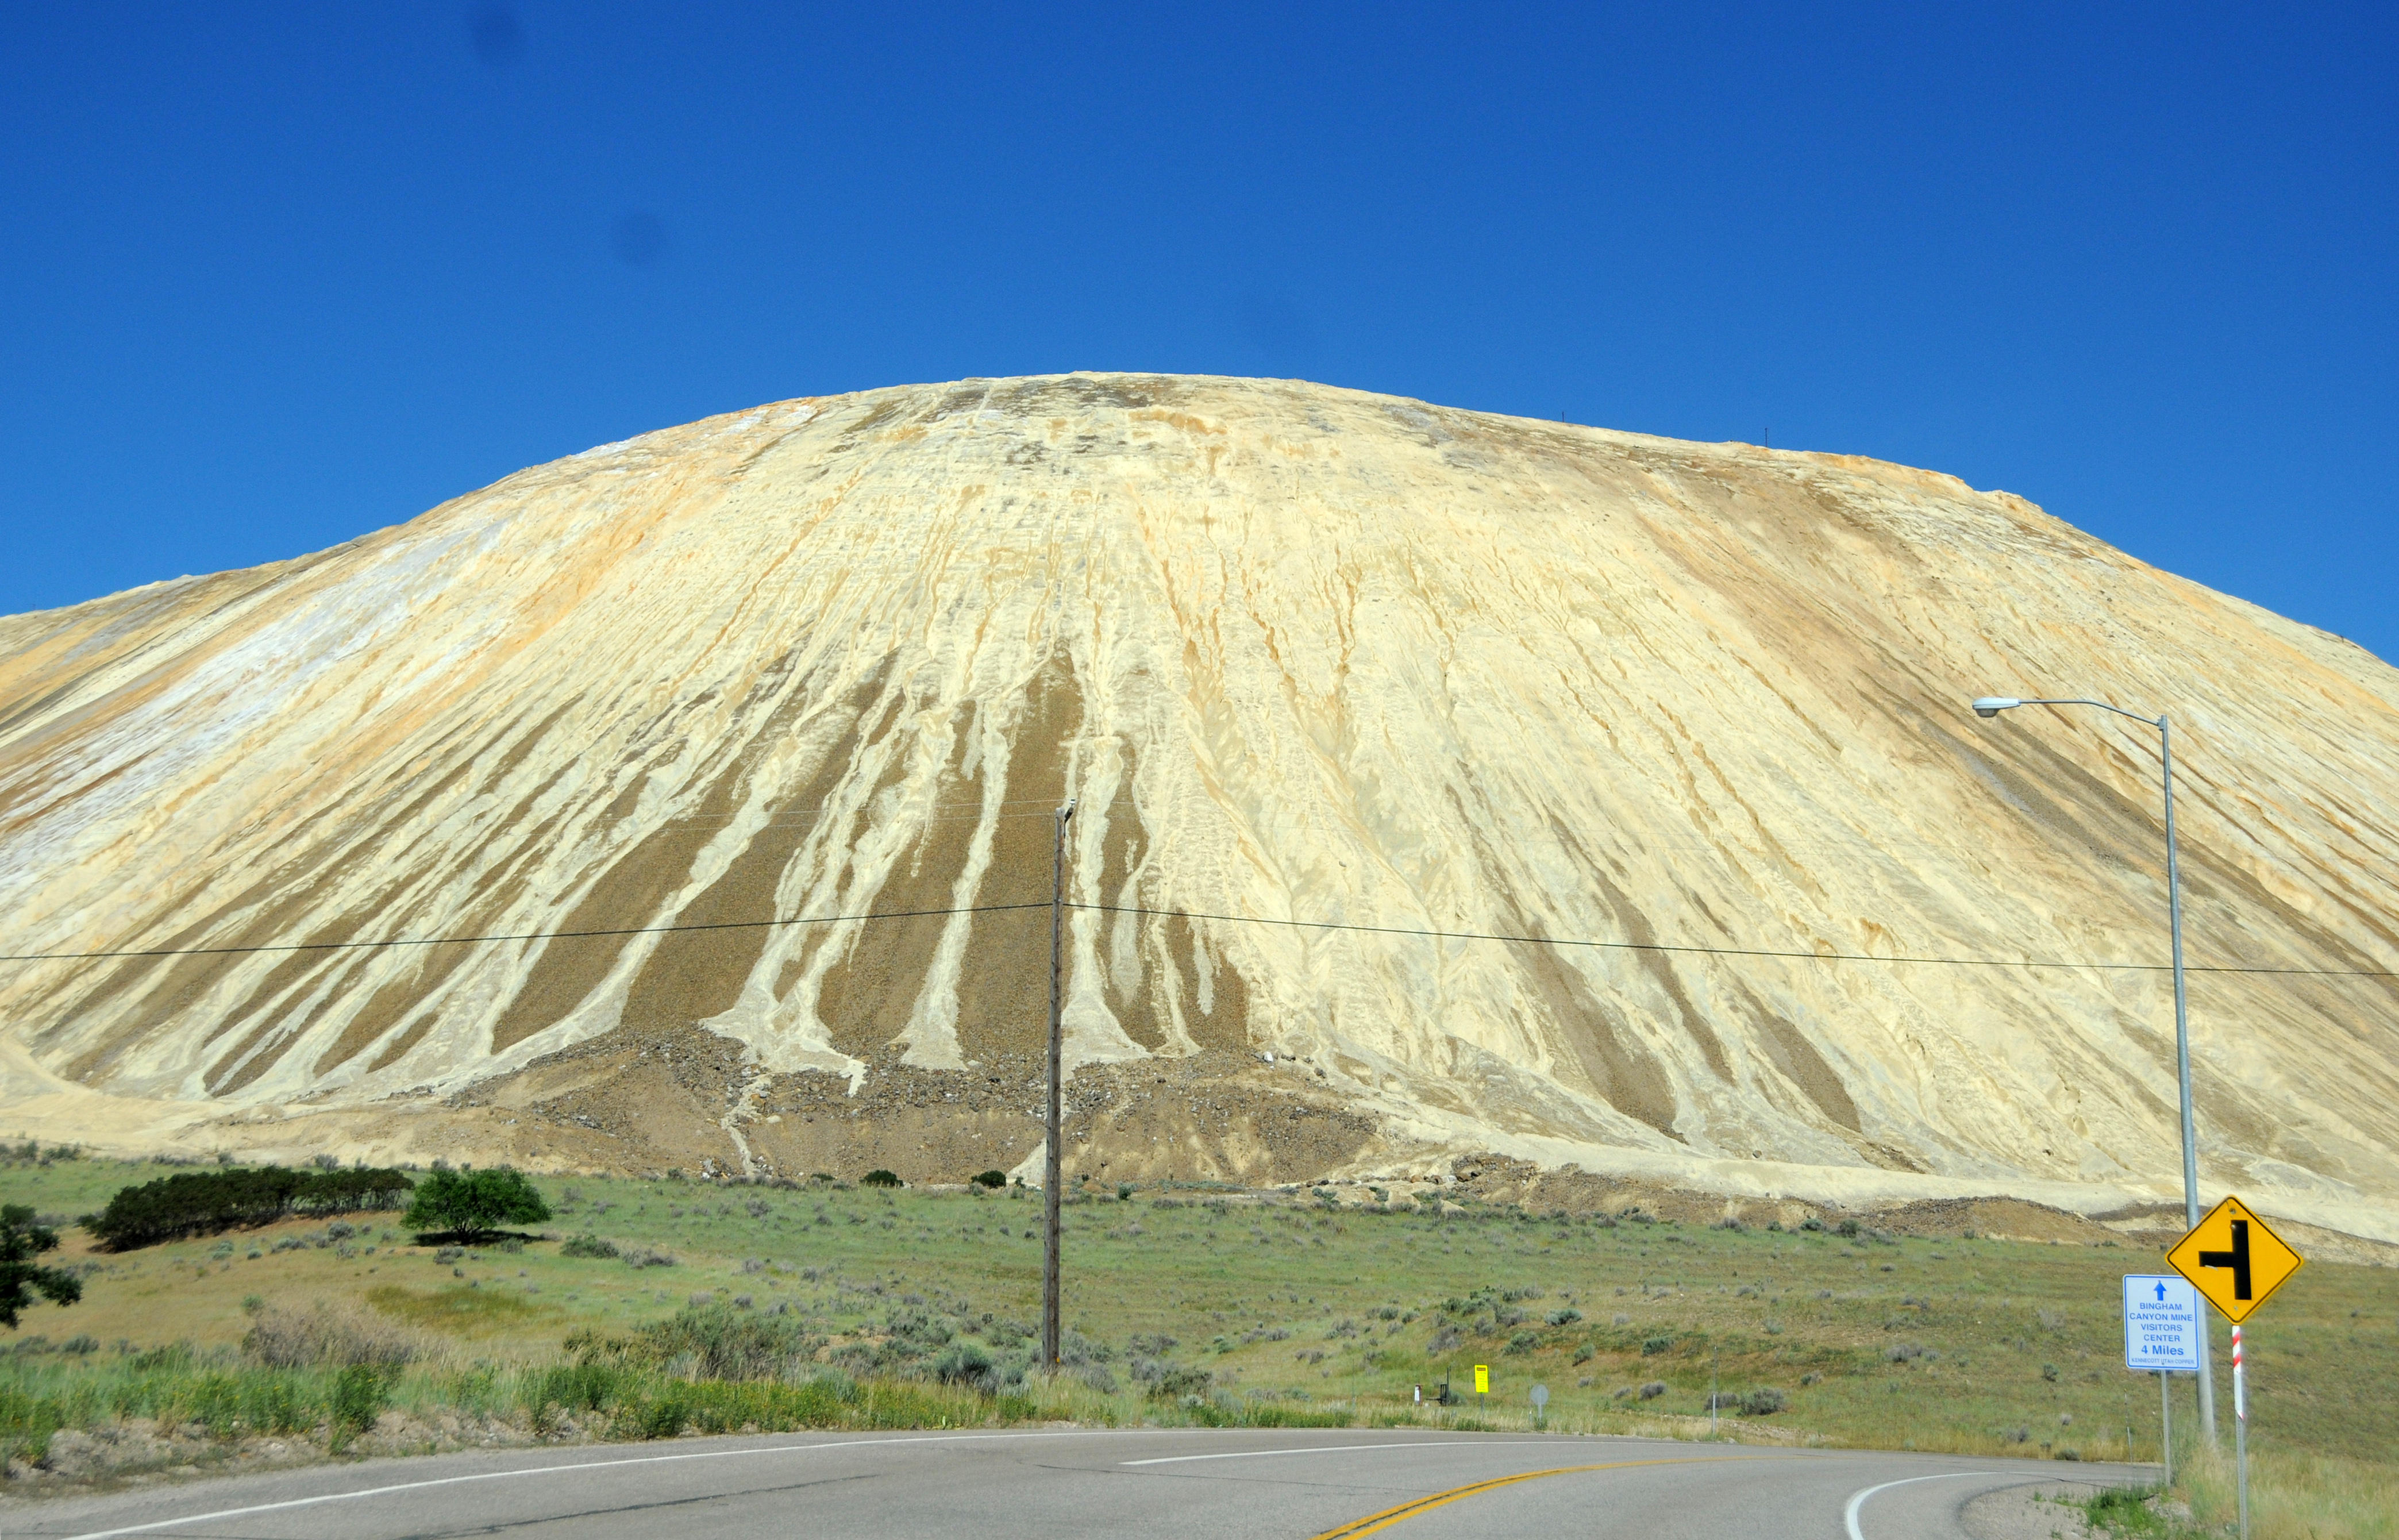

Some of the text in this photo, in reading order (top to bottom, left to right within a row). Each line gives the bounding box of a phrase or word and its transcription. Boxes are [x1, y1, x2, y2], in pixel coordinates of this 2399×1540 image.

[2140, 1323, 2182, 1331] VISITORS
[2141, 1345, 2184, 1356] 4 Miles
